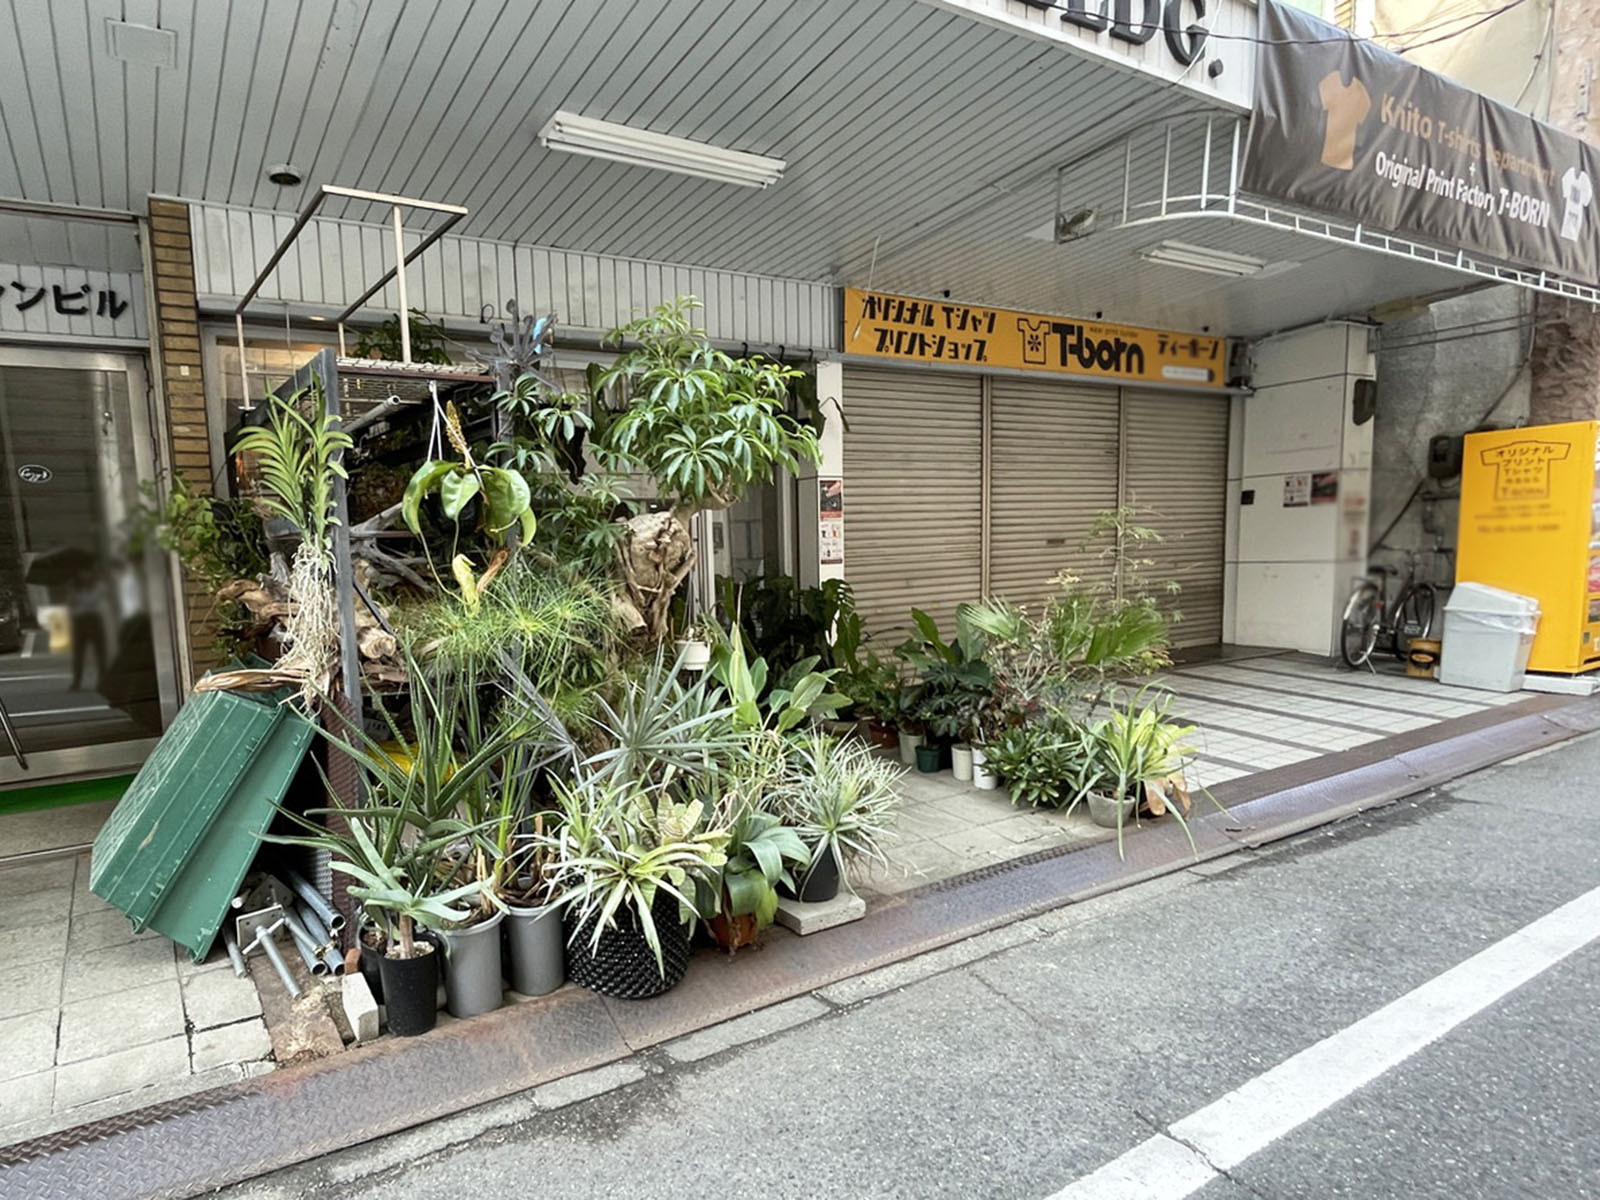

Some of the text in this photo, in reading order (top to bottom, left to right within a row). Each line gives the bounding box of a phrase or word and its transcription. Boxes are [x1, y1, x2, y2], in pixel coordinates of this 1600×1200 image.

[1375, 151, 1551, 228] Original Print Factory T-BORN
[0, 281, 128, 319] ンビル
[874, 328, 988, 362] プリントショップ
[1052, 322, 1144, 375] T-born
[1496, 446, 1554, 458] オリジナル
